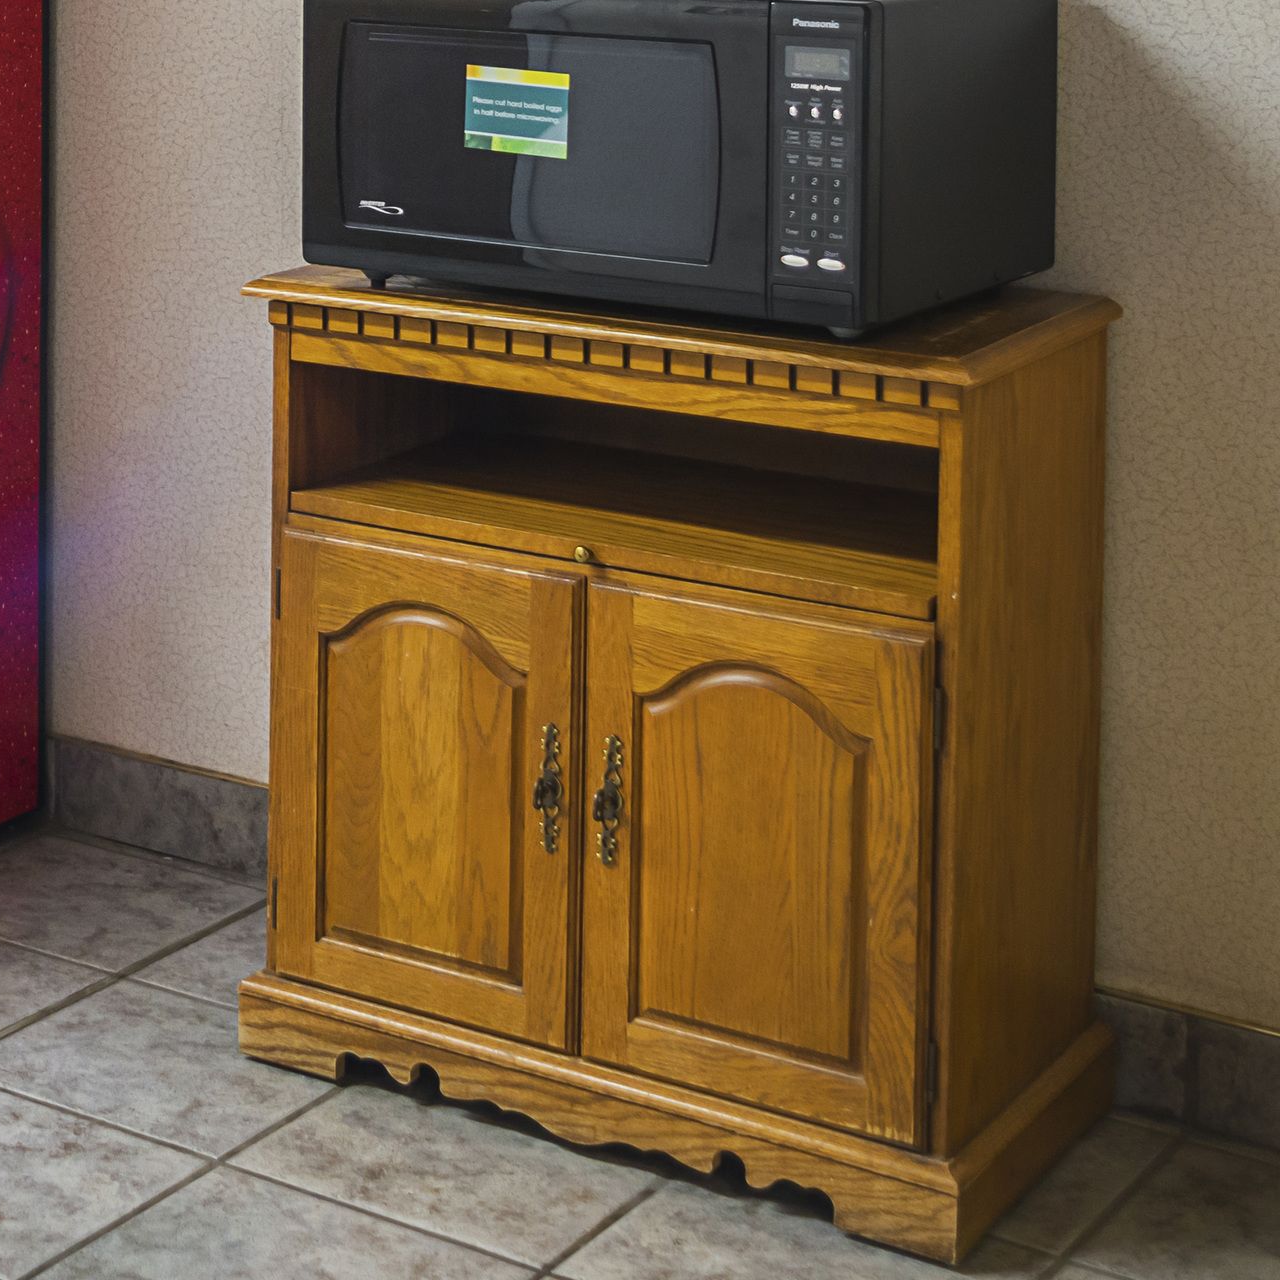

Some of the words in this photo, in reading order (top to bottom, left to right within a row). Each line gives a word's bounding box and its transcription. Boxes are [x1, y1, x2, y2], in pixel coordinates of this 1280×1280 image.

[792, 17, 840, 29] Panasonic
[472, 96, 494, 105] Please
[495, 99, 506, 107] cut
[506, 100, 523, 109] hard
[523, 101, 545, 111] boiled
[545, 104, 563, 114] eggs
[481, 109, 494, 117] half
[494, 110, 516, 119] before
[790, 175, 795, 183] 1
[811, 177, 818, 186] 2
[833, 179, 840, 188] 3
[811, 195, 818, 203] 5
[833, 197, 840, 205] 6
[789, 210, 796, 218] 7
[810, 212, 817, 221] 8
[833, 215, 839, 223] 9
[810, 230, 817, 238] 0
